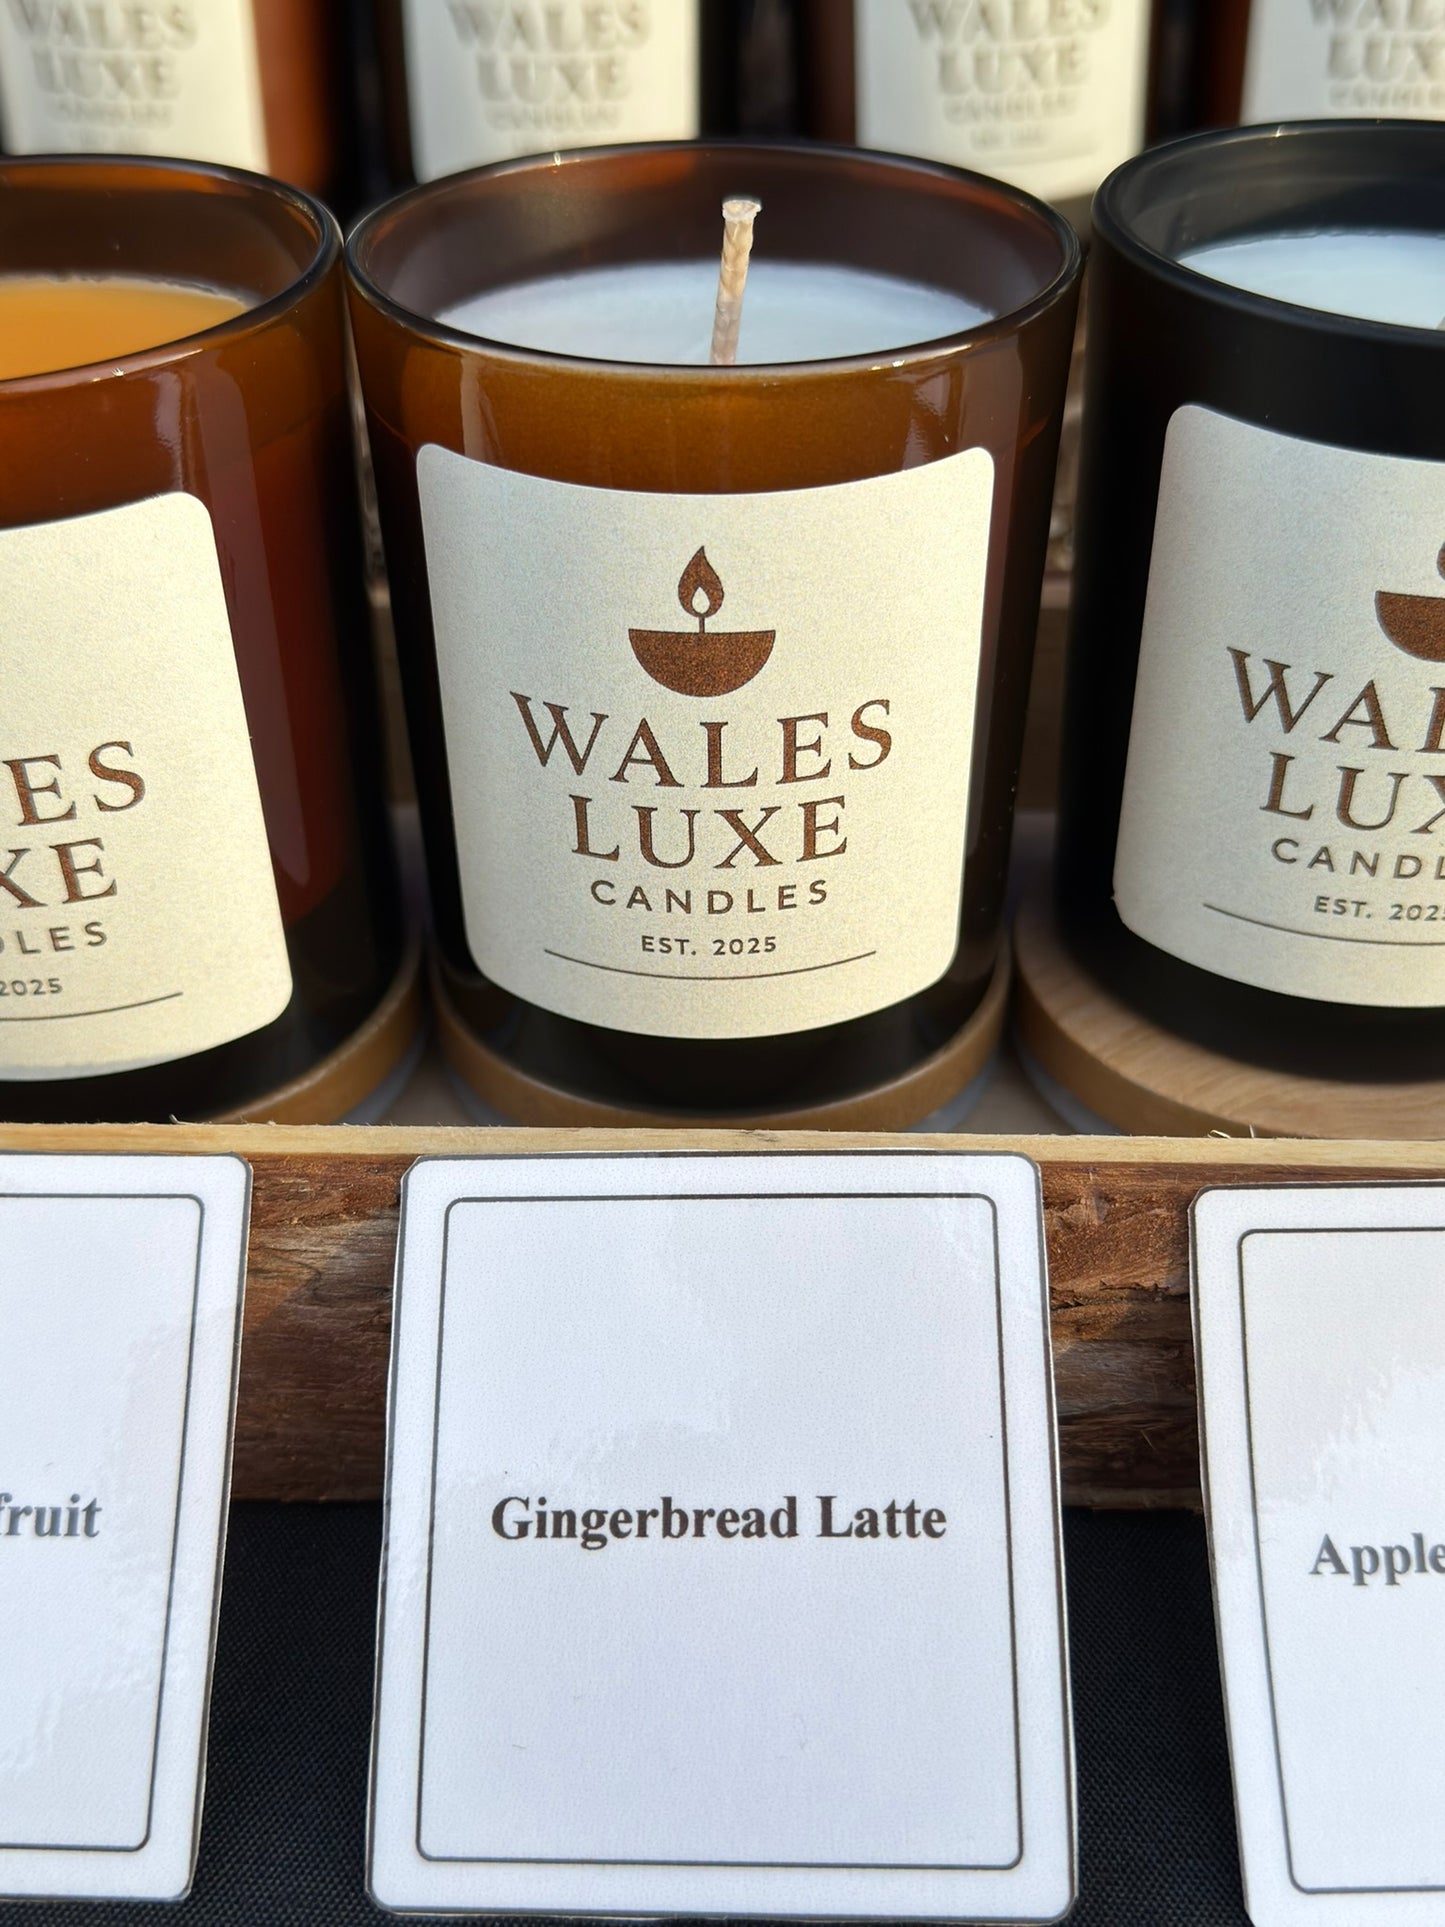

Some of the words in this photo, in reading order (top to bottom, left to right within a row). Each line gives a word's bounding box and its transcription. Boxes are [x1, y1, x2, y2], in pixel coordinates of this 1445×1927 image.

[510, 691, 892, 788] WALES
[3, 740, 147, 826] ES
[569, 794, 847, 869] LUXE
[590, 879, 828, 915] CANDLES
[1314, 896, 1372, 919] EST.
[641, 935, 697, 956] EST.
[713, 936, 777, 956] 2025
[491, 1496, 799, 1550] Gingerbread
[816, 1496, 947, 1538] Latte
[1308, 1532, 1445, 1586] Apple
